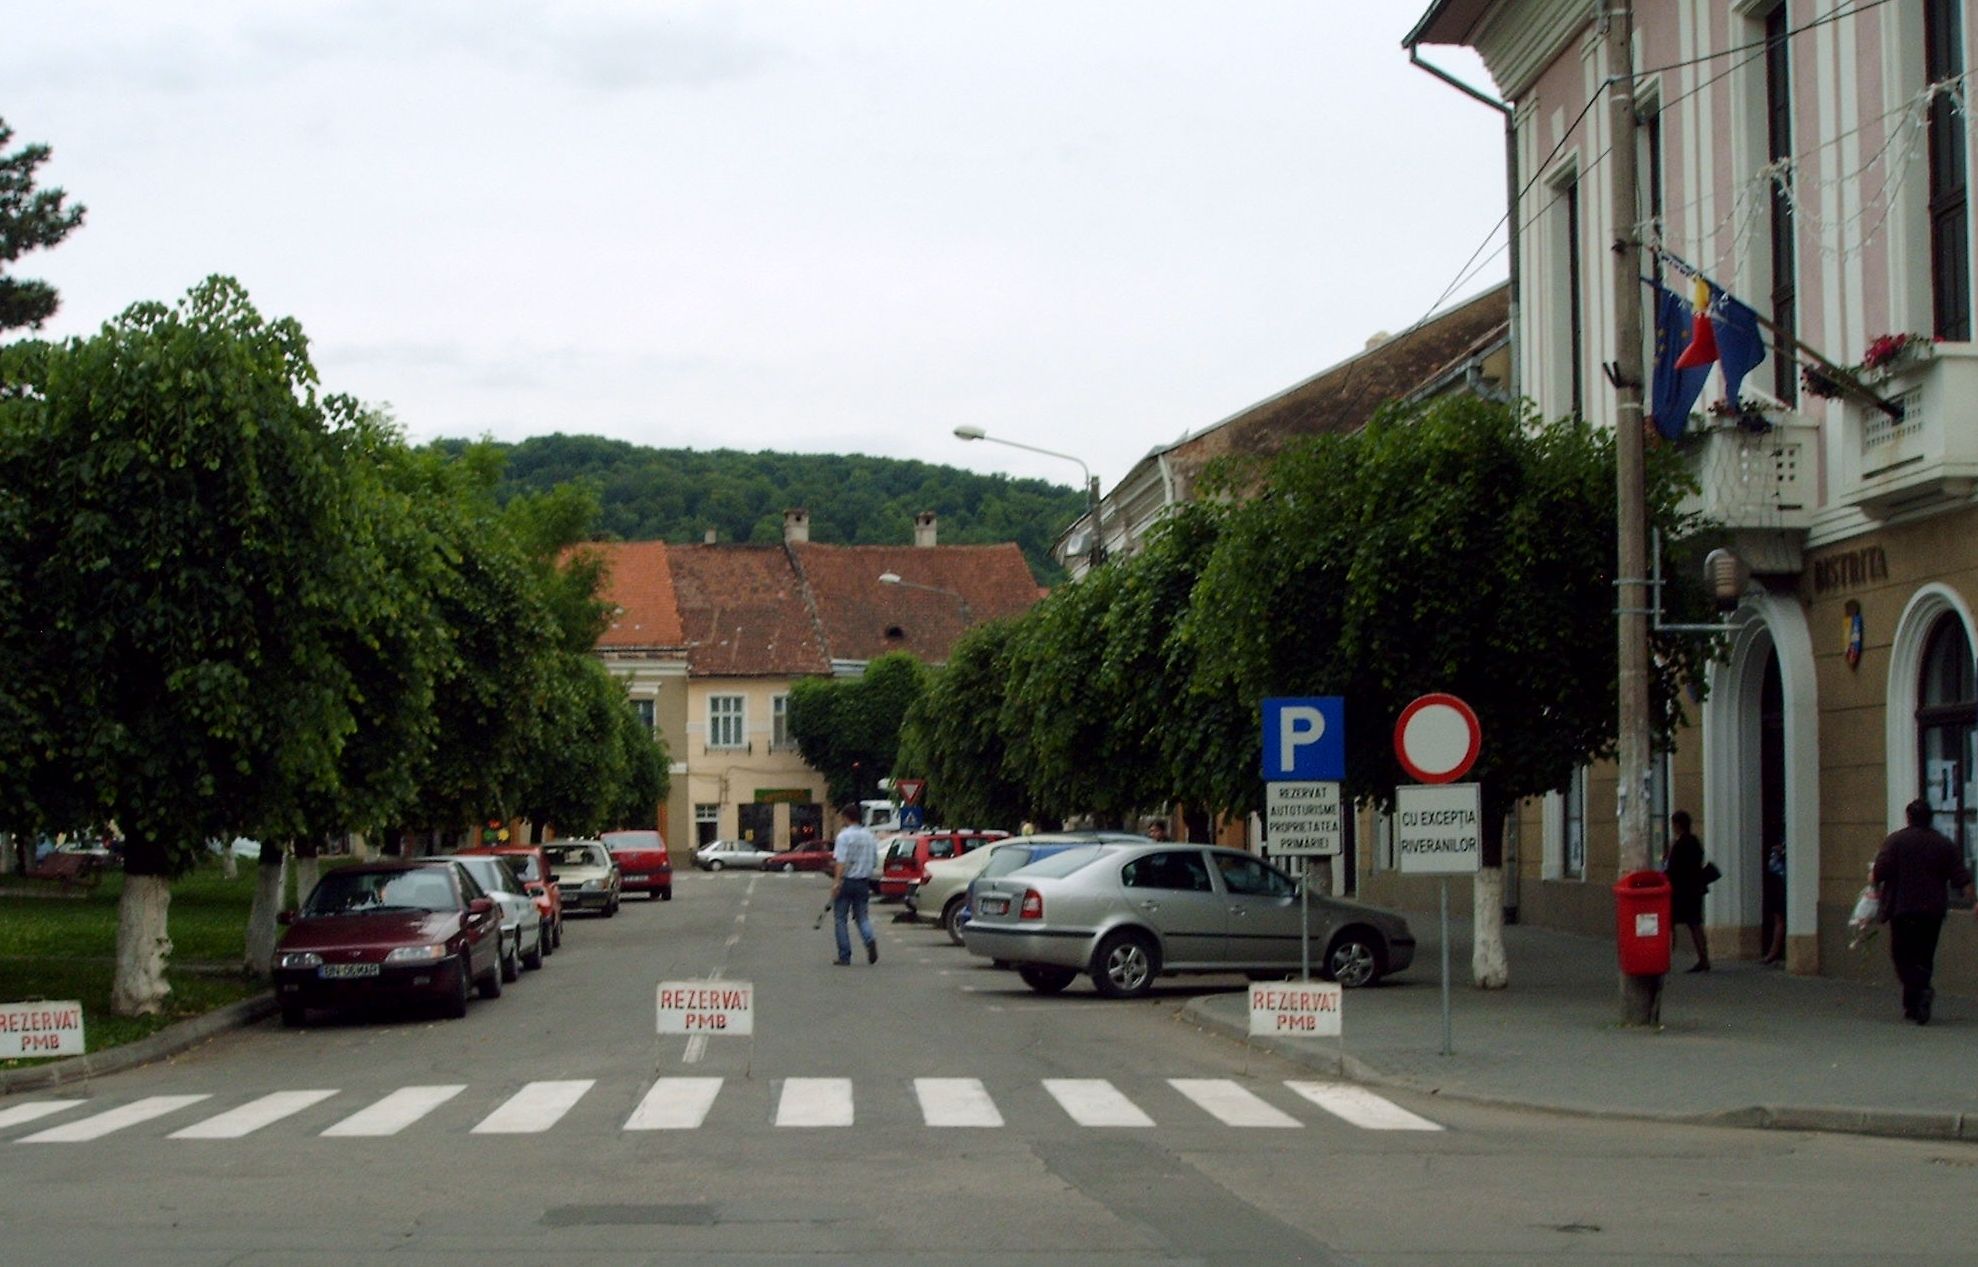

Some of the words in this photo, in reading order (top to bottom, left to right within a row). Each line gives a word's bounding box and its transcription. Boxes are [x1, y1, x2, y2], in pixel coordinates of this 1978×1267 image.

[1280, 706, 1326, 772] P
[1279, 787, 1327, 798] REZERVAT
[1270, 804, 1337, 816] AUTOTURISME
[1269, 821, 1339, 832] PROPRIETATEA
[1402, 812, 1418, 826] CU
[1401, 837, 1477, 854] RIVERANILOR
[661, 990, 751, 1010] REZERVAT
[1253, 991, 1338, 1012] REZERVAT
[0, 1010, 79, 1032] REZERVAT
[685, 1013, 727, 1030] PMB
[1276, 1015, 1316, 1031] PMB
[21, 1033, 60, 1051] PMB
